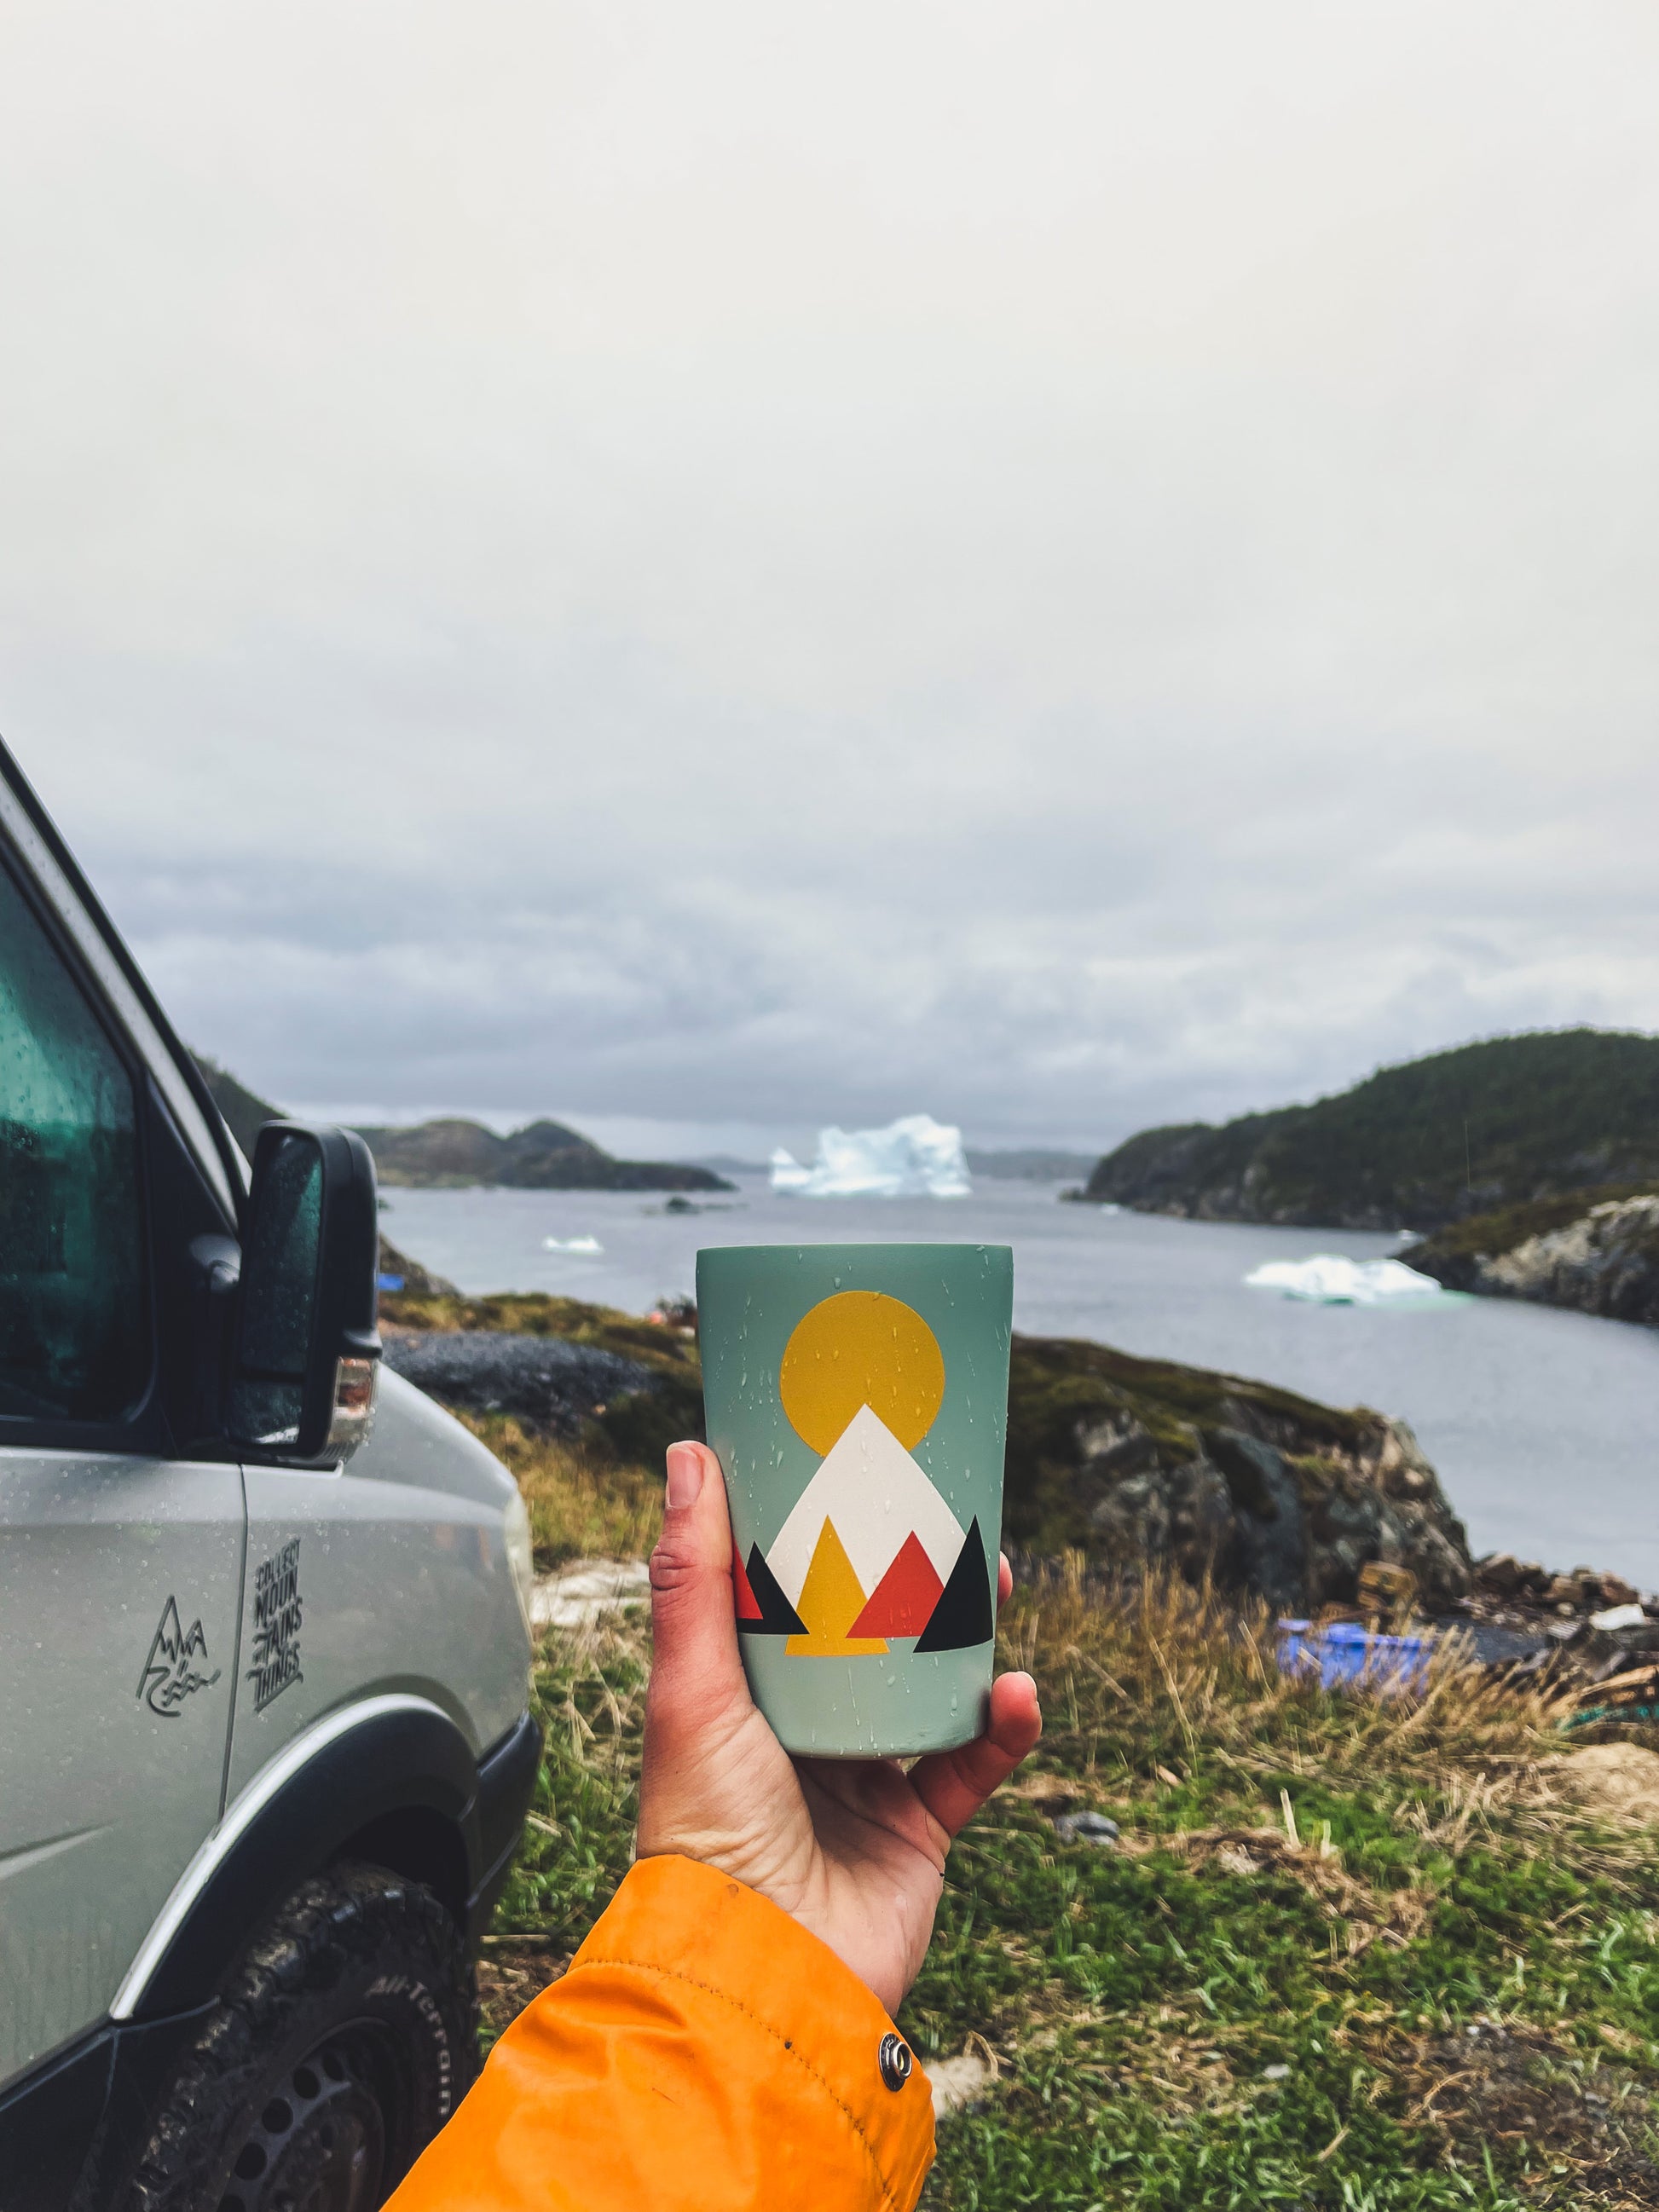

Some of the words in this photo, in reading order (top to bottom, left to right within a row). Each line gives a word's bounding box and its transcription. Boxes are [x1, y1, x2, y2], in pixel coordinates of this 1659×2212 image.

[255, 1564, 298, 1629] MOUN
[256, 1538, 300, 1591] COLLECT
[246, 1641, 300, 1705] THINGS
